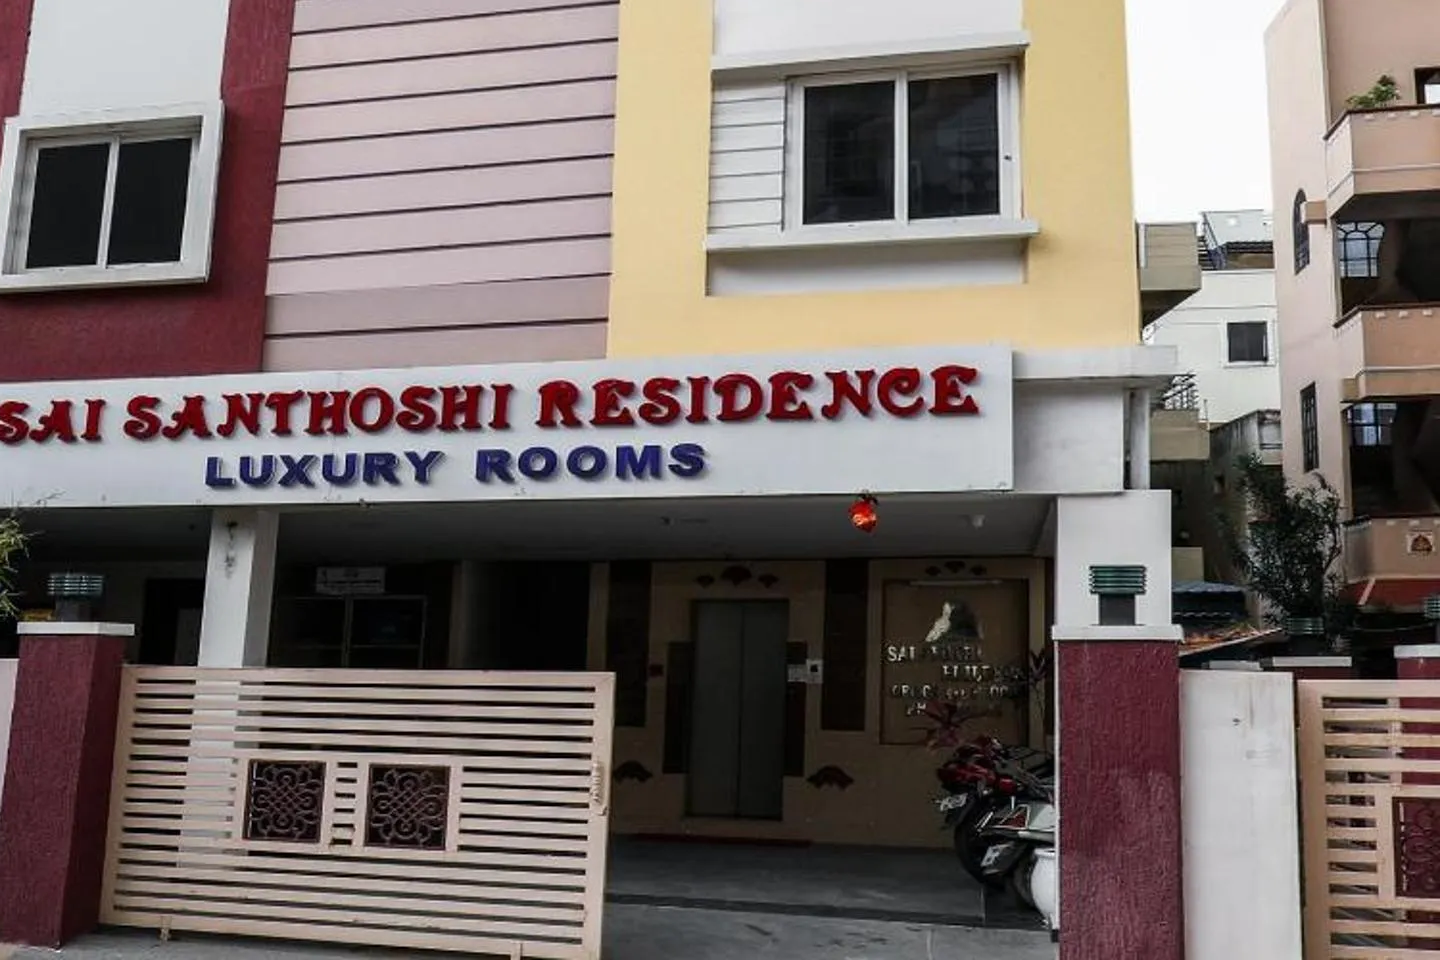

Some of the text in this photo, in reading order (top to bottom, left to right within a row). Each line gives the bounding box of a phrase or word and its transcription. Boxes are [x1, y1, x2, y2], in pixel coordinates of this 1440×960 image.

[122, 383, 515, 440] SANTHOSHI
[535, 364, 980, 429] RESIDENCE
[205, 442, 707, 489] LUXURY ROOMS
